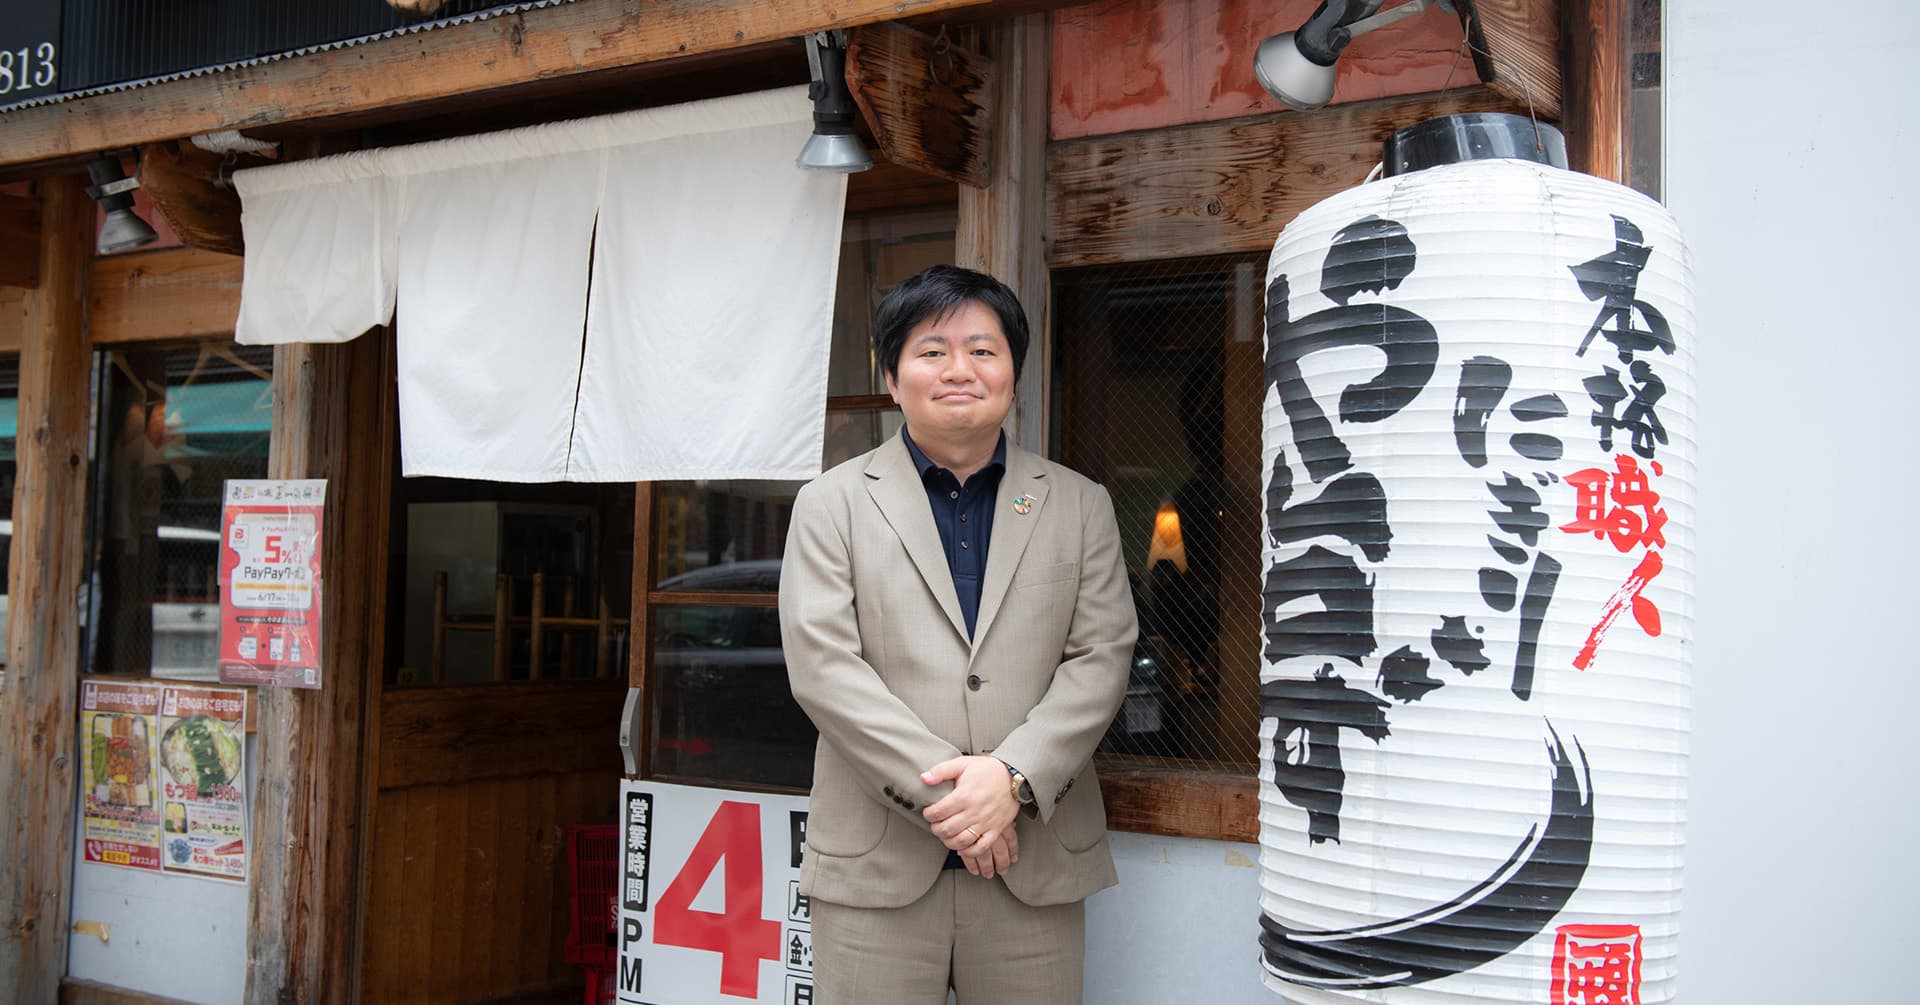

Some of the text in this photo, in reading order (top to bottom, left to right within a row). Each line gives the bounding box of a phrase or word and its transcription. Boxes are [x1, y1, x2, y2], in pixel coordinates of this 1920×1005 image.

[0, 42, 55, 94] 813
[1560, 213, 1676, 671] 本格職人
[1454, 355, 1569, 702] にぎり
[626, 797, 649, 905] 営業時間
[653, 800, 782, 999] 4
[620, 917, 643, 993] PM
